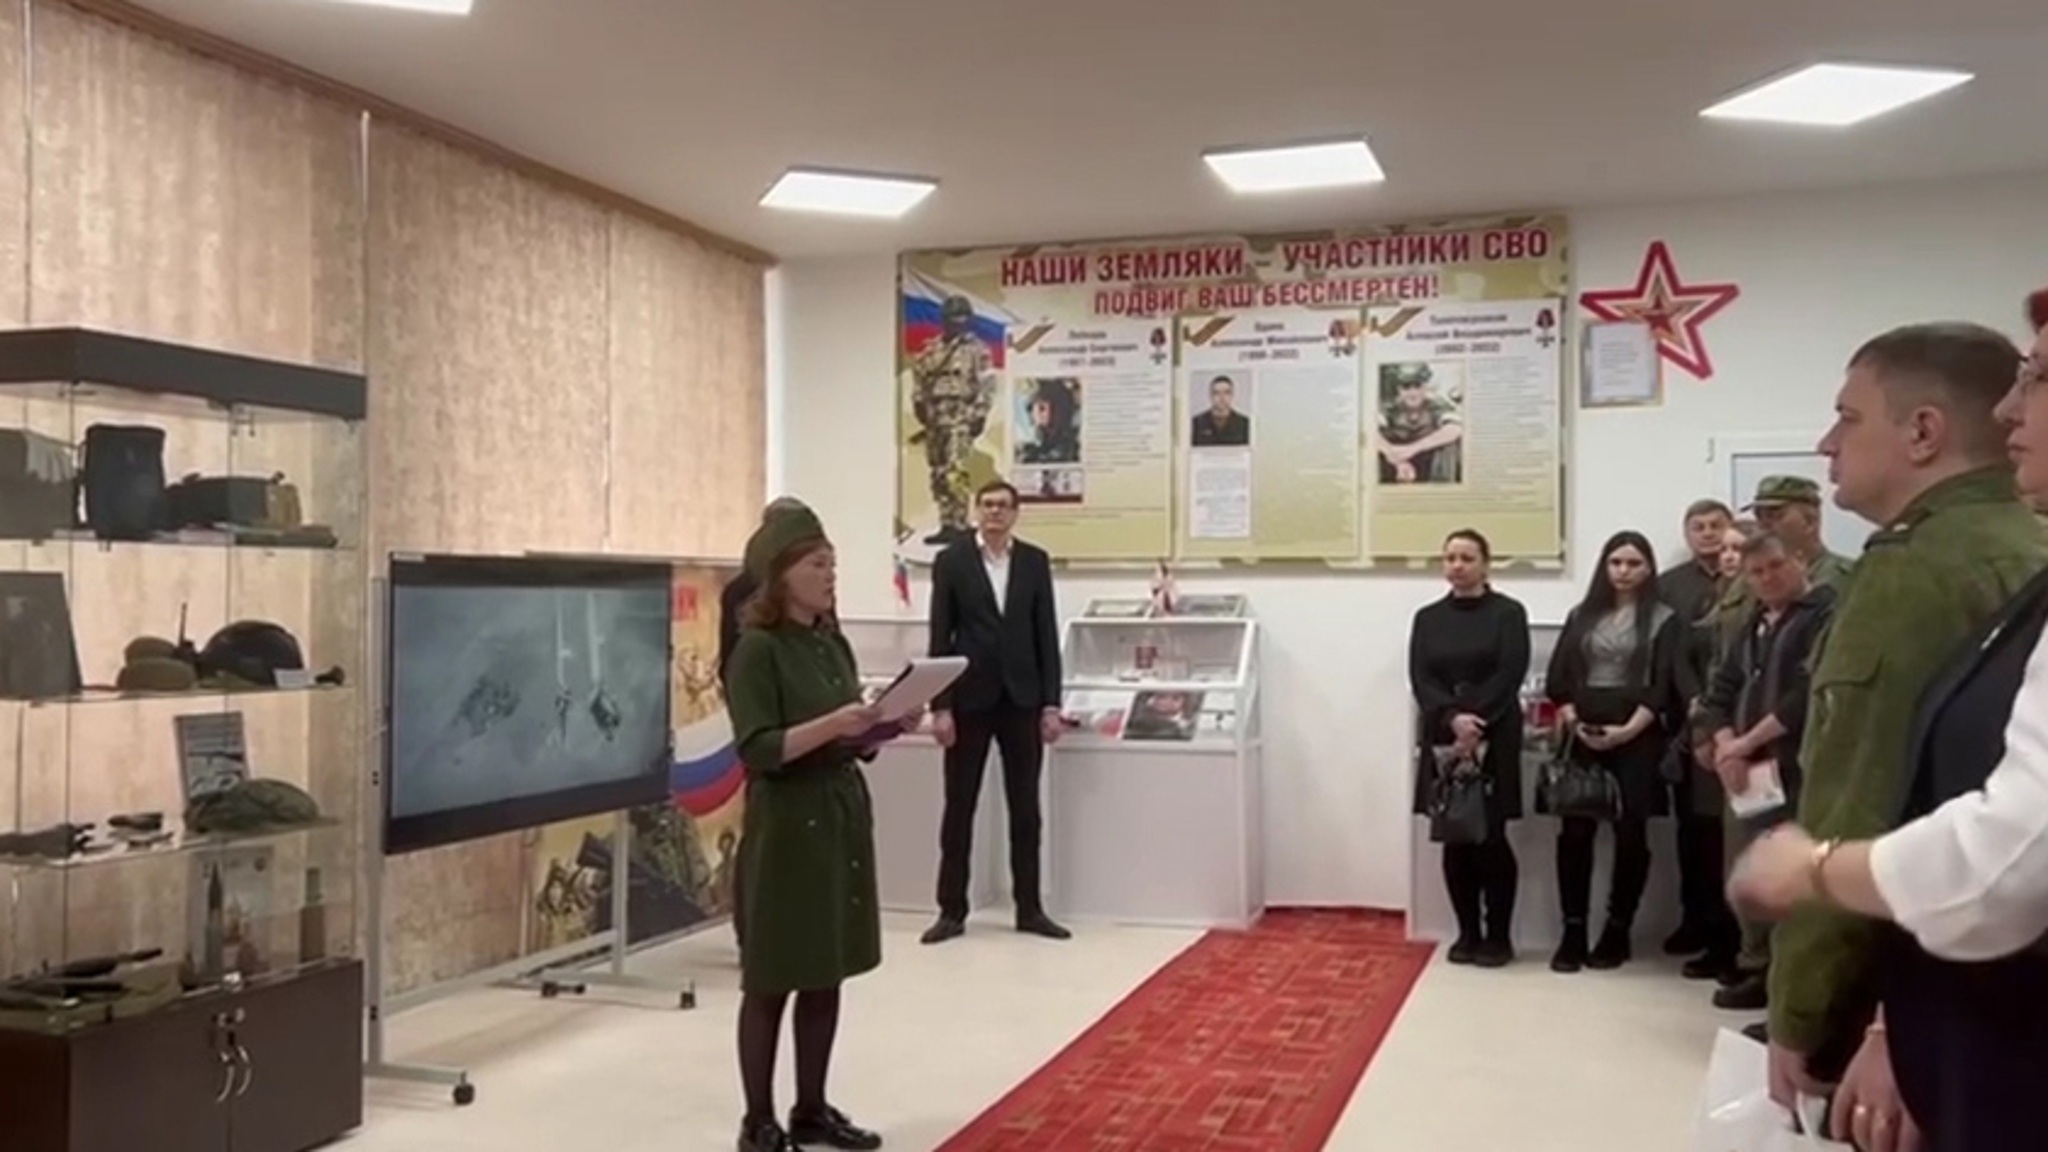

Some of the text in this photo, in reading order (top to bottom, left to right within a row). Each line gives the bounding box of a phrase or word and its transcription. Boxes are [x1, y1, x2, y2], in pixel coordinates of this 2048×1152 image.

[1001, 256, 1086, 287] НАШИ
[1096, 248, 1243, 281] ЗЕМЛЯКИ
[1283, 234, 1470, 271] УЧАСТНИКИ
[1482, 230, 1548, 260] СВО
[1094, 275, 1440, 316] ПОДВИГ ВАШ БЕССМЕРТЕН!
